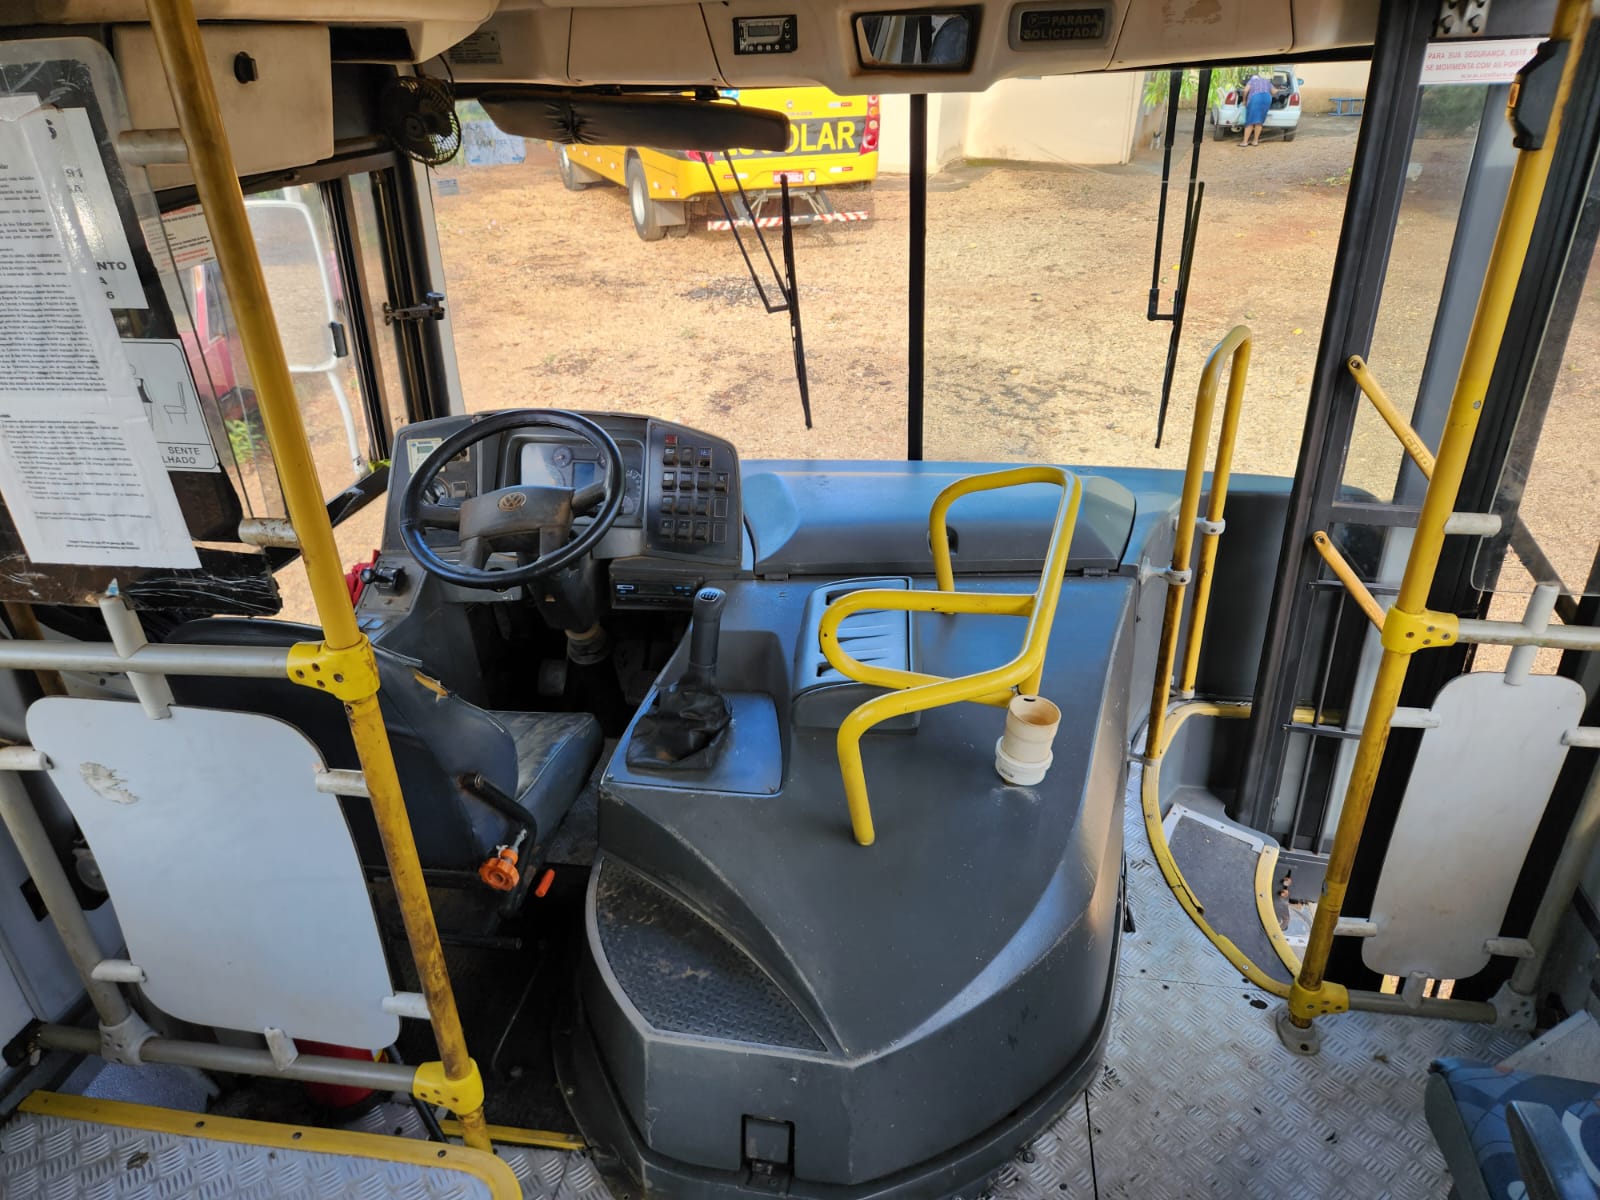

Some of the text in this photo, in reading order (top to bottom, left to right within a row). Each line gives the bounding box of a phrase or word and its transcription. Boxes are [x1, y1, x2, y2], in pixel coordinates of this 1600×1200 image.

[1050, 14, 1098, 26] PARADA
[1023, 27, 1099, 40] SOLICITADA
[95, 261, 127, 270] NTO
[167, 446, 201, 455] SENTE
[161, 455, 197, 464] LHADO
